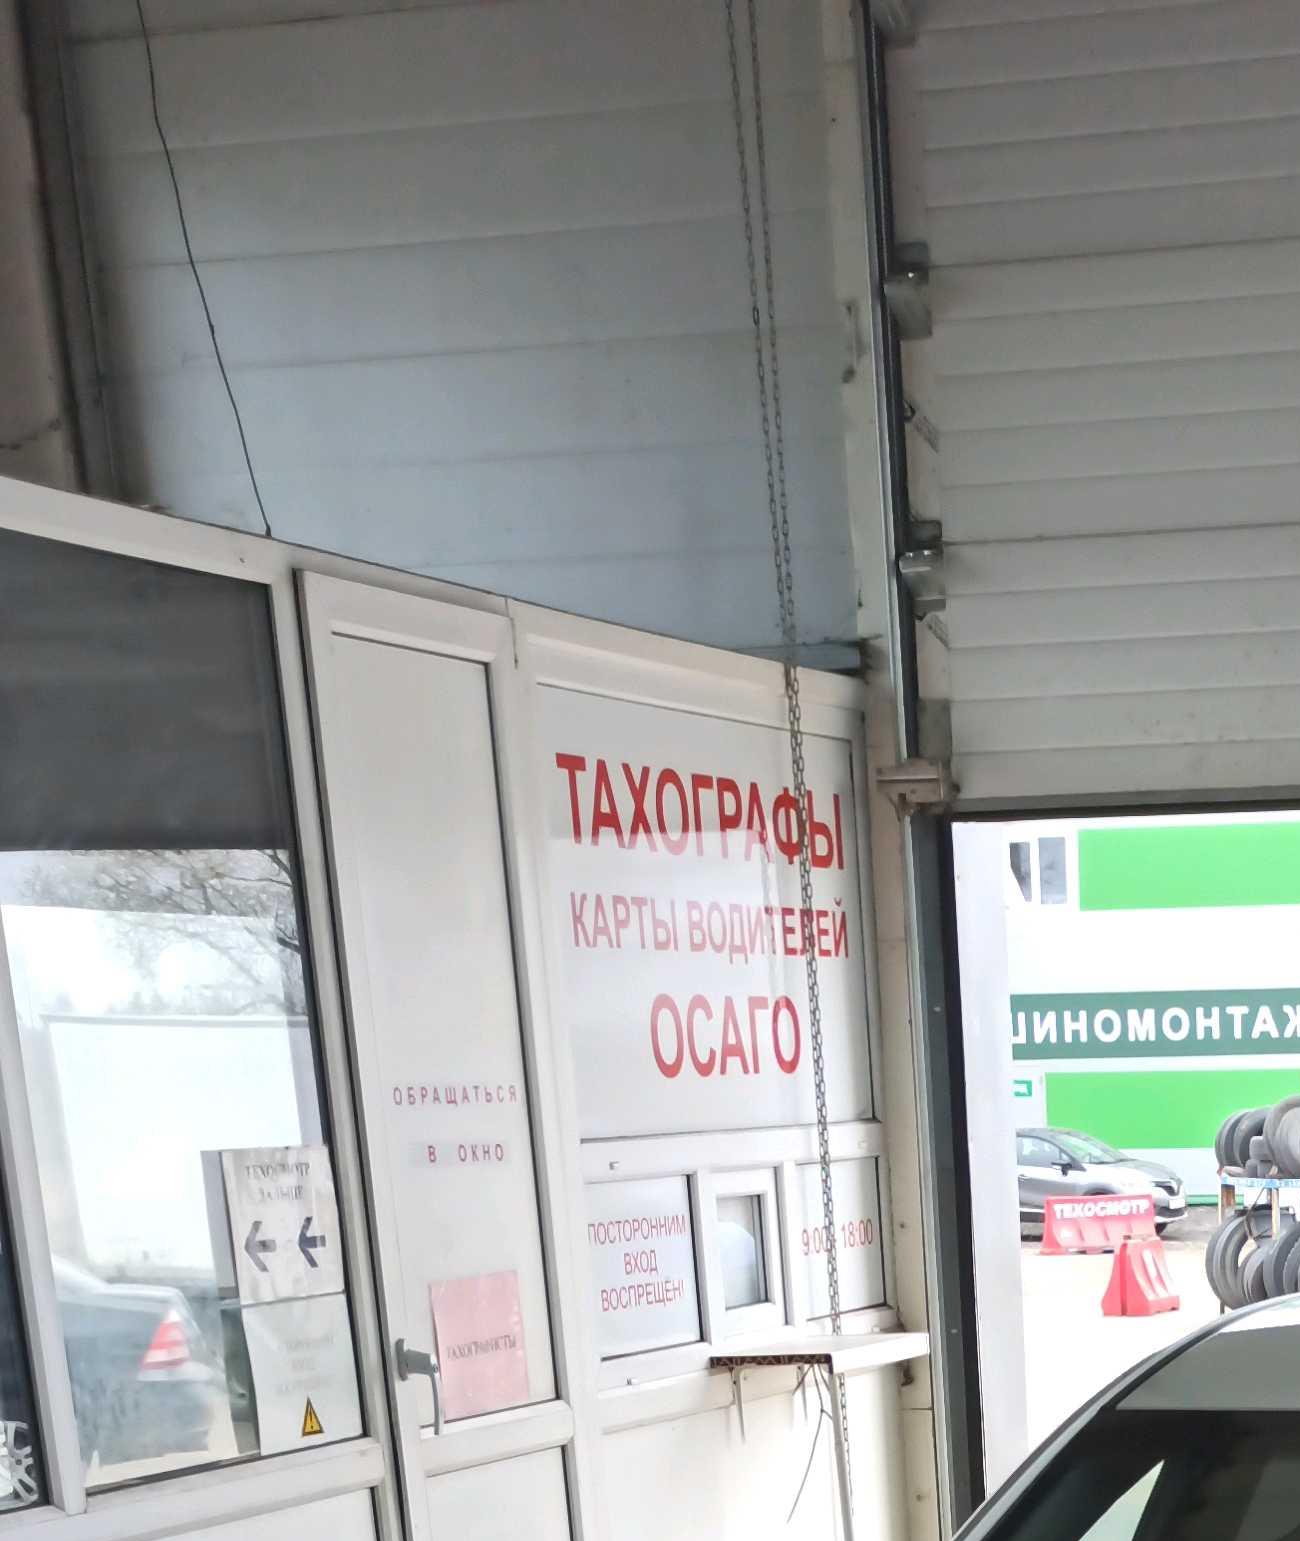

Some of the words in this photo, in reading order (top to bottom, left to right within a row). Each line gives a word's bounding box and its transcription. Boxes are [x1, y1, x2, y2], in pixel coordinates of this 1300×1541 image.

[555, 752, 844, 870] ТАХОГРАФЫ
[570, 891, 679, 951] КАРТЫ
[687, 898, 849, 965] ВОДИТЕЛЕЙ
[650, 993, 801, 1079] ОСАГО
[393, 1085, 518, 1107] ОБРАЩАТЬСЯ
[427, 1145, 437, 1164] В
[459, 1143, 505, 1163] ОКНО
[1053, 1199, 1151, 1220] ТЕХОСМОТР
[587, 1214, 687, 1245] ПОСТОРОННИМ
[841, 1218, 873, 1249] 18:00
[623, 1250, 658, 1276] ВХОД
